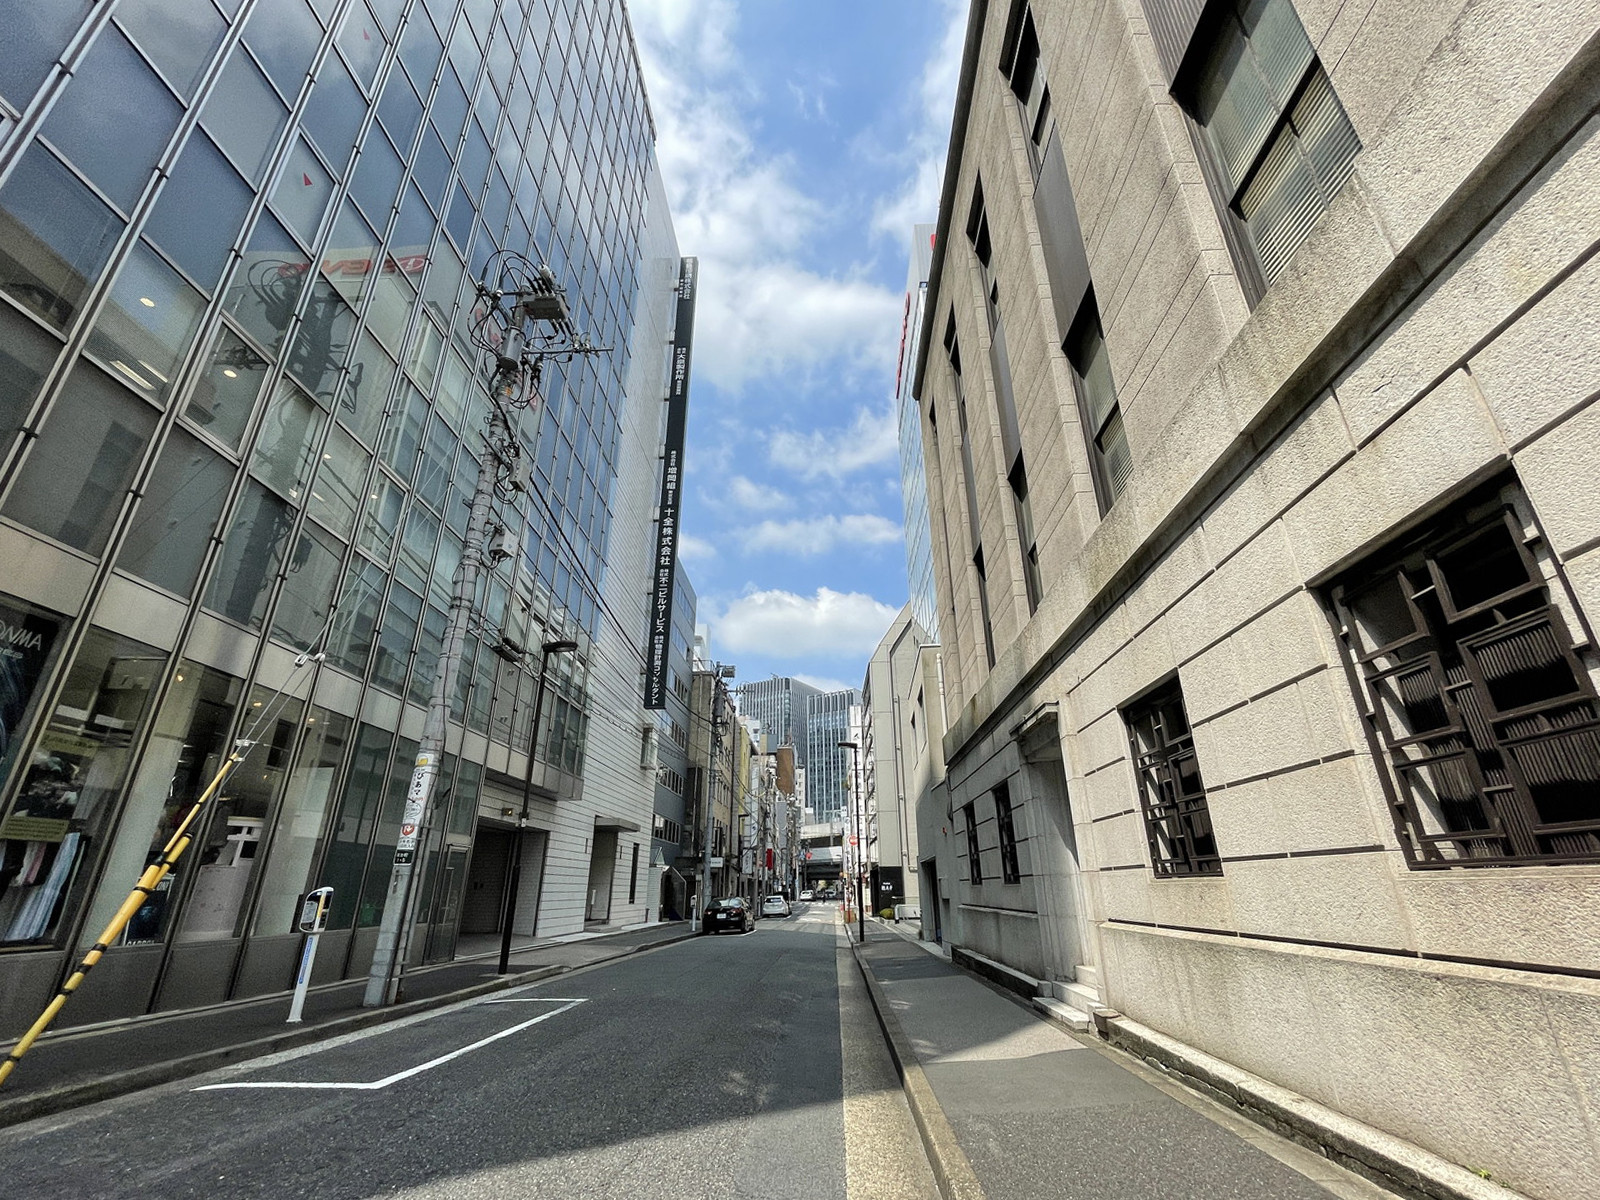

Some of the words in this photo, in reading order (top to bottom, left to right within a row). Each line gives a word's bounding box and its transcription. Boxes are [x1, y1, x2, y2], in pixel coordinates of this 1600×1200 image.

[660, 507, 674, 565] 十全株式会社
[656, 577, 669, 633] 不二ビルサービス
